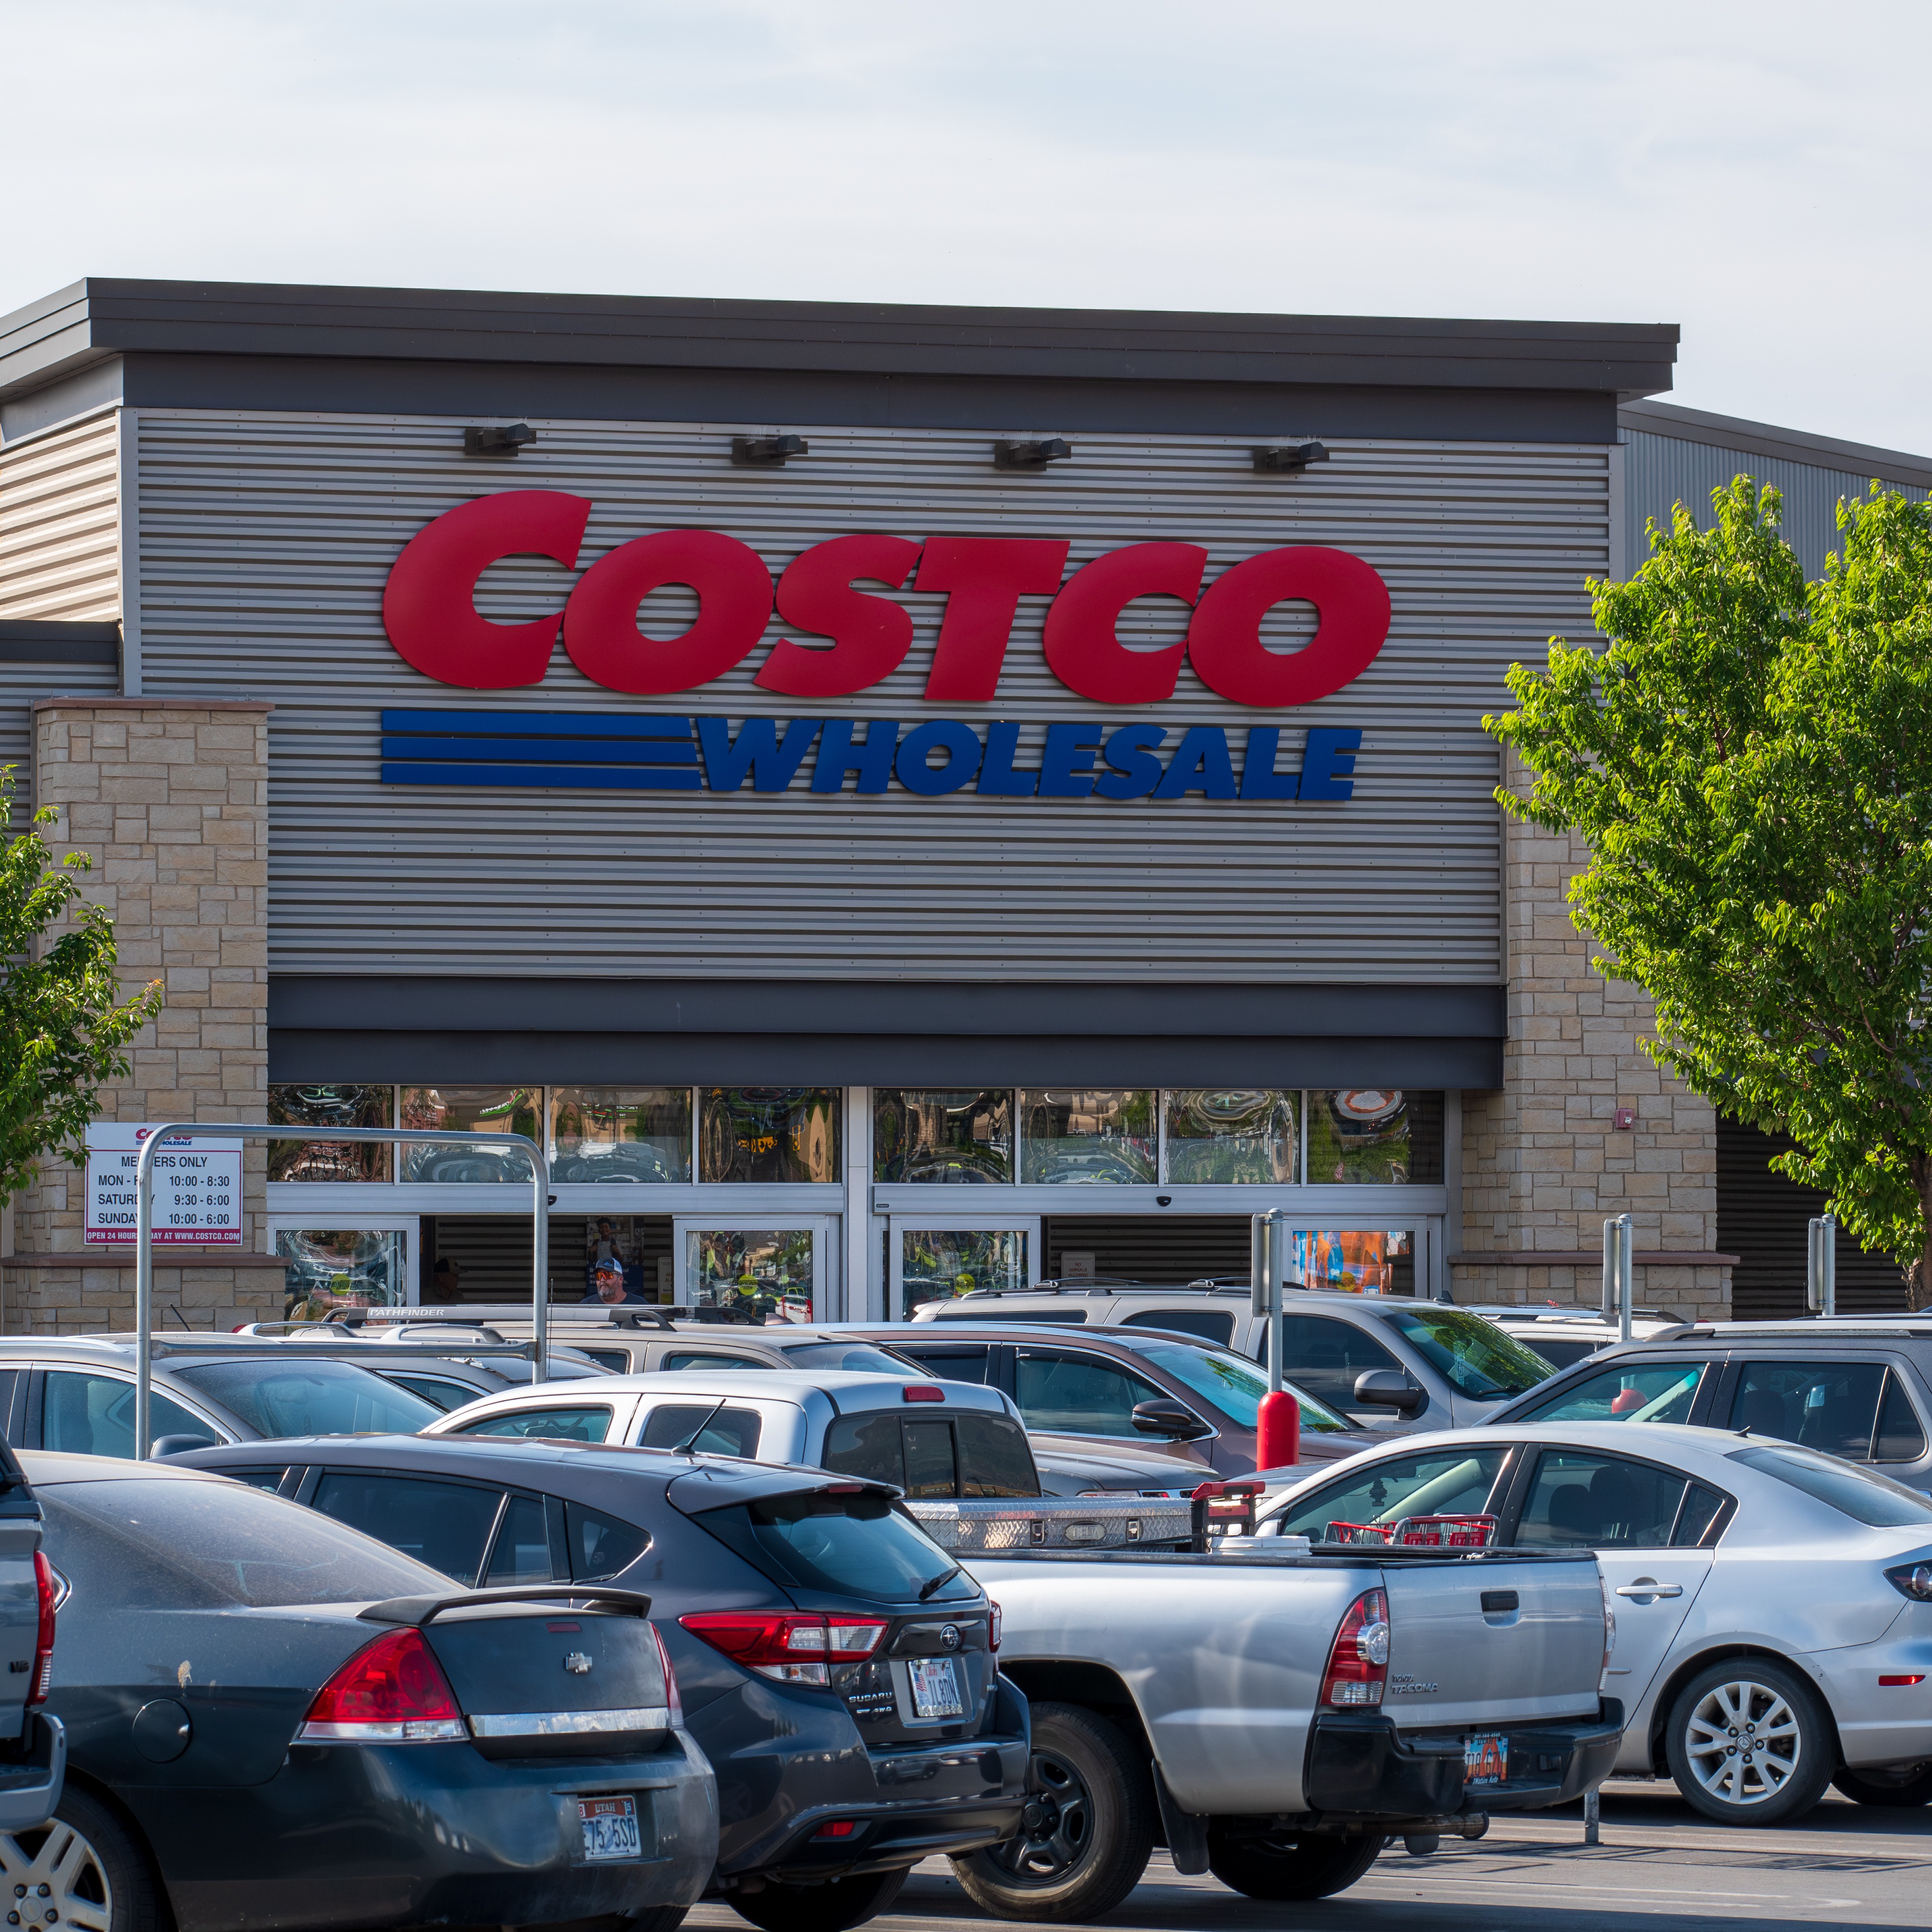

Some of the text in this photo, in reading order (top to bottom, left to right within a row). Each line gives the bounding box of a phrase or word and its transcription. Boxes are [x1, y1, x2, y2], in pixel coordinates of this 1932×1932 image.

[383, 490, 1391, 707] COSTCO
[695, 717, 1363, 801] WHOLESALE
[122, 1156, 208, 1167] MEERS ONLY
[98, 1175, 123, 1186] MON
[170, 1176, 197, 1186] 10:00
[207, 1176, 230, 1186] 8:30
[174, 1194, 197, 1205] 9:30
[207, 1194, 229, 1205] 6:00
[98, 1213, 137, 1224] SUNDA
[169, 1213, 197, 1224] 10:00
[207, 1213, 229, 1224] 6:00
[926, 1666, 937, 1676] Utah
[1392, 1674, 1414, 1682] TOYOTA
[1391, 1683, 1438, 1694] TACOMA
[849, 1692, 892, 1703] SUBARU
[595, 1802, 616, 1813] UTAH
